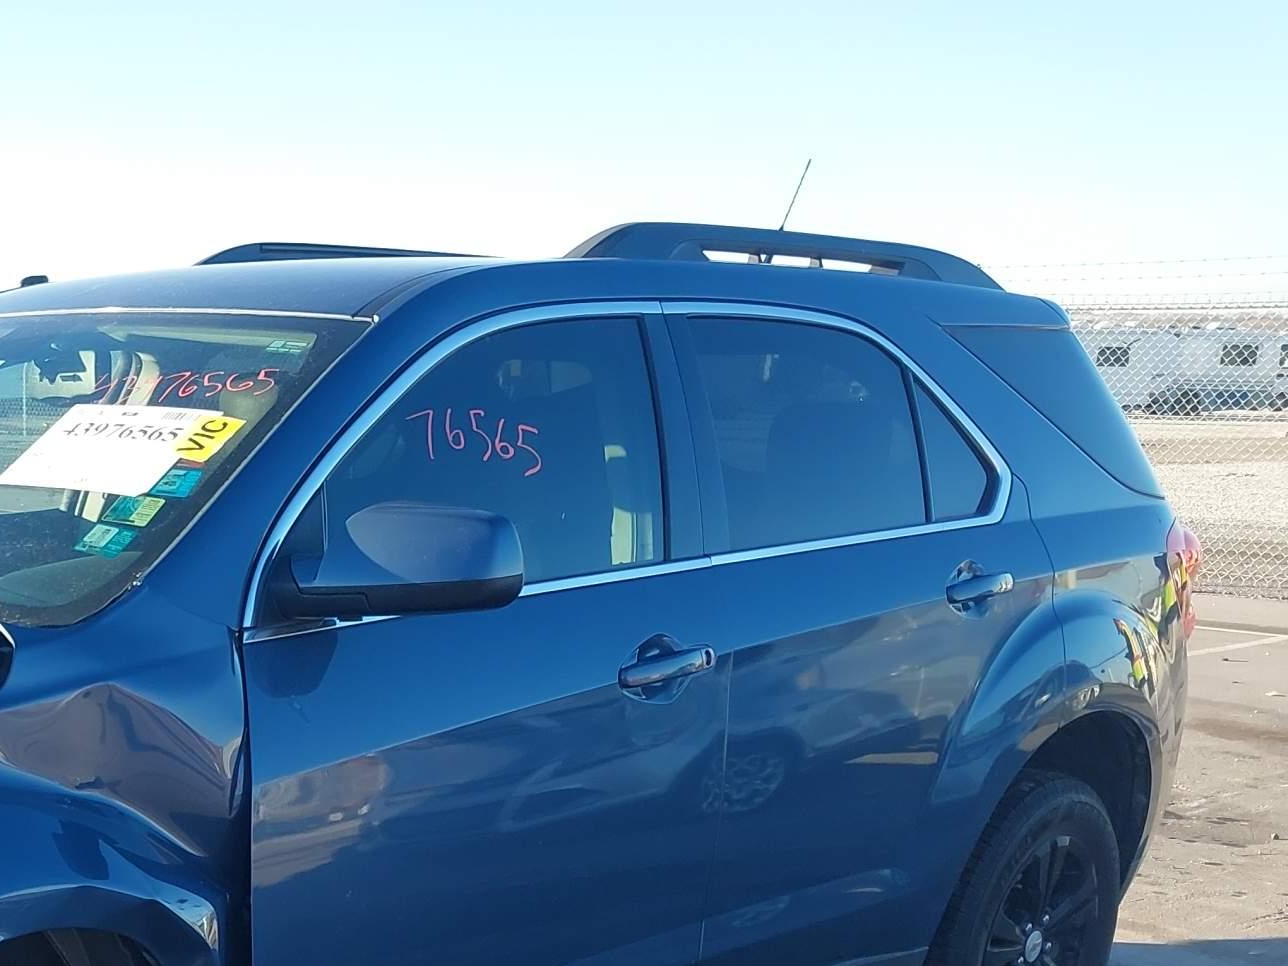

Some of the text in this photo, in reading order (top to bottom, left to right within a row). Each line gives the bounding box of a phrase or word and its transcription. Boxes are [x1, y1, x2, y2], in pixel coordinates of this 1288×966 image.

[63, 421, 185, 442] 43976565
[176, 419, 228, 452] VIC
[406, 408, 543, 477] 76565
